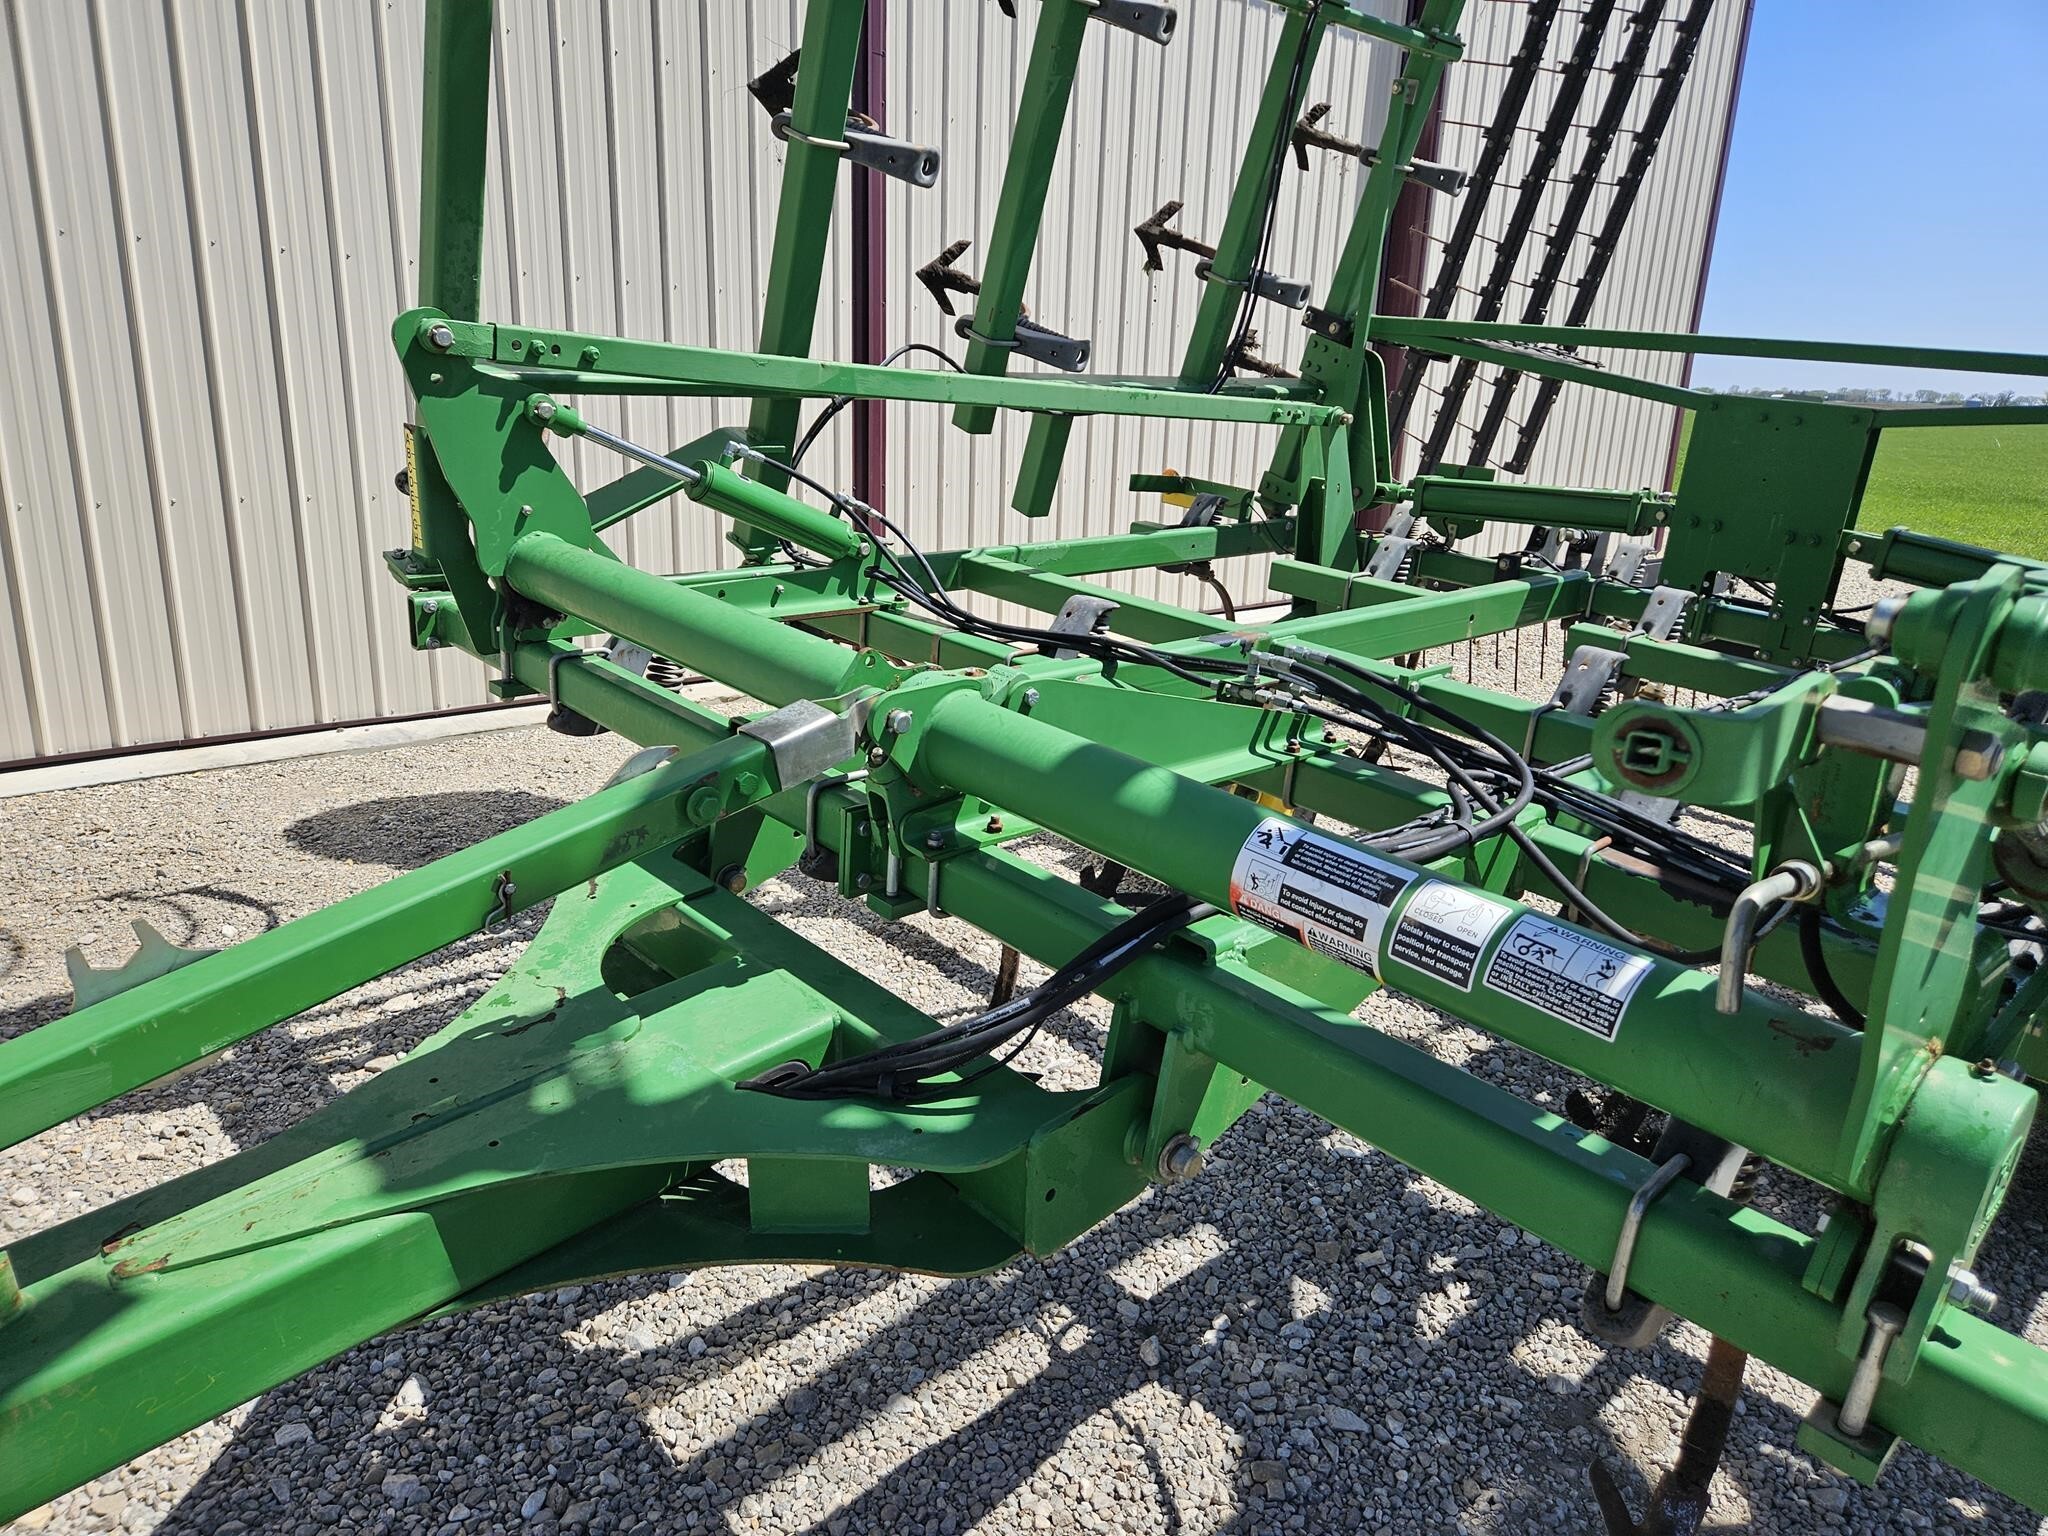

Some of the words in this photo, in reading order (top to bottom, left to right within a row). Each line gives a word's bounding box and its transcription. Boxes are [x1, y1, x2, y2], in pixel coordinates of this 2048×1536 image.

[1280, 898, 1291, 907] not
[1292, 903, 1314, 916] contact
[1315, 913, 1337, 927] electric
[1339, 923, 1356, 935] lines.
[1282, 888, 1290, 896] To
[1291, 893, 1308, 904] avoid
[1309, 900, 1327, 914] injury
[1336, 912, 1354, 924] death
[1355, 920, 1363, 928] do
[1414, 908, 1444, 924] CLOSED
[1318, 931, 1372, 961] WARNING
[1401, 922, 1424, 937] Rotate
[1424, 931, 1442, 944] lever
[1442, 940, 1450, 948] to
[1451, 945, 1475, 959] closed
[1457, 926, 1478, 939] OPEN
[1560, 929, 1626, 959] WARNING
[1394, 944, 1420, 960] service,
[1421, 956, 1435, 966] and
[1436, 962, 1464, 979] storage.
[1396, 934, 1424, 949] position
[1426, 945, 1436, 954] for
[1437, 950, 1470, 971] transport,
[1493, 963, 1514, 978] during
[1548, 987, 1572, 1002] CLOSE
[1572, 998, 1596, 1014] lockup
[1596, 1009, 1615, 1021] valve
[1496, 958, 1524, 974] machine
[1525, 970, 1554, 988] lowering
[1565, 987, 1581, 997] loss
[1591, 998, 1618, 1014] control
[1508, 956, 1525, 966] avoid
[1525, 963, 1550, 978] serious
[1551, 973, 1570, 987] injury
[1579, 985, 1599, 997] death
[1599, 995, 1612, 1004] due
[1488, 976, 1508, 989] before
[1508, 984, 1544, 1006] transporting
[1552, 1005, 1581, 1022] servicing
[1500, 973, 1530, 991] INSTALL
[1532, 987, 1563, 1005] cylinder
[1564, 1002, 1586, 1016] clevis
[1588, 1013, 1609, 1027] locks
